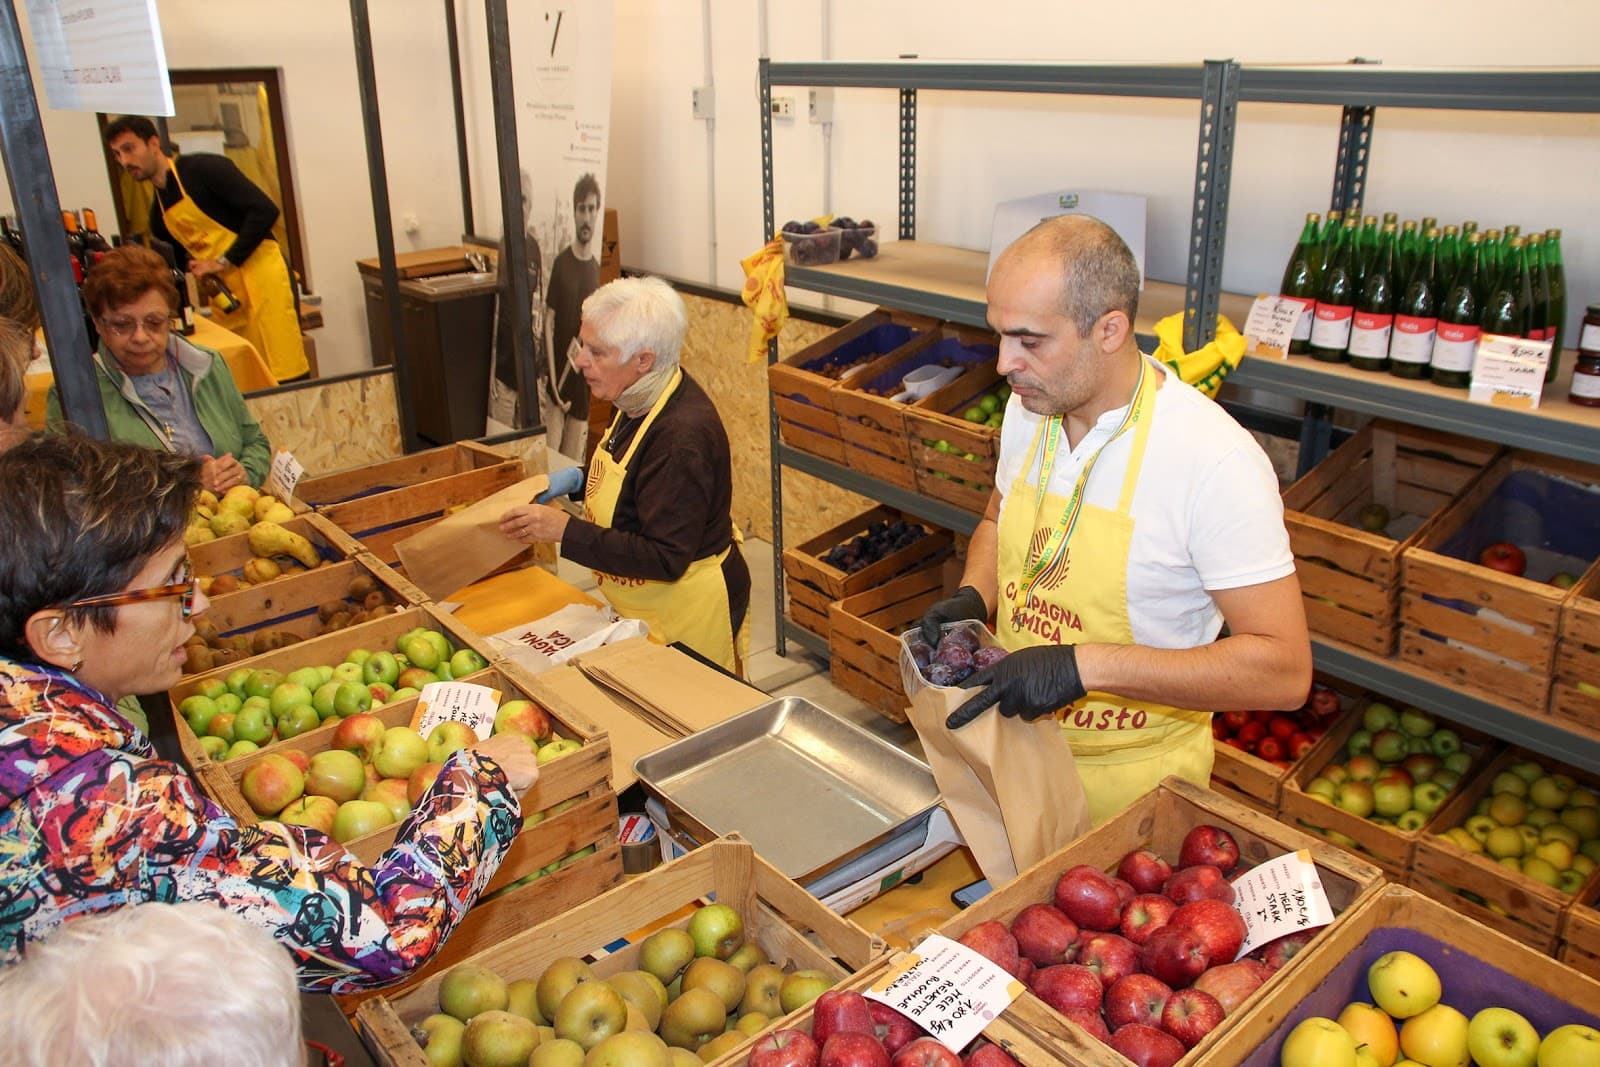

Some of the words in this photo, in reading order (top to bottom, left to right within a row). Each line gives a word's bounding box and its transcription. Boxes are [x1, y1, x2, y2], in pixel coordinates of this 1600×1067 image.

[1006, 582, 1083, 632] CPAGNA
[1266, 893, 1282, 923] STARK
[1279, 891, 1293, 914] MELE
[897, 975, 939, 1010] RUGGINE
[912, 979, 953, 1016] RENETTE
[936, 988, 962, 1012] MELE
[952, 999, 973, 1020] 1,80
